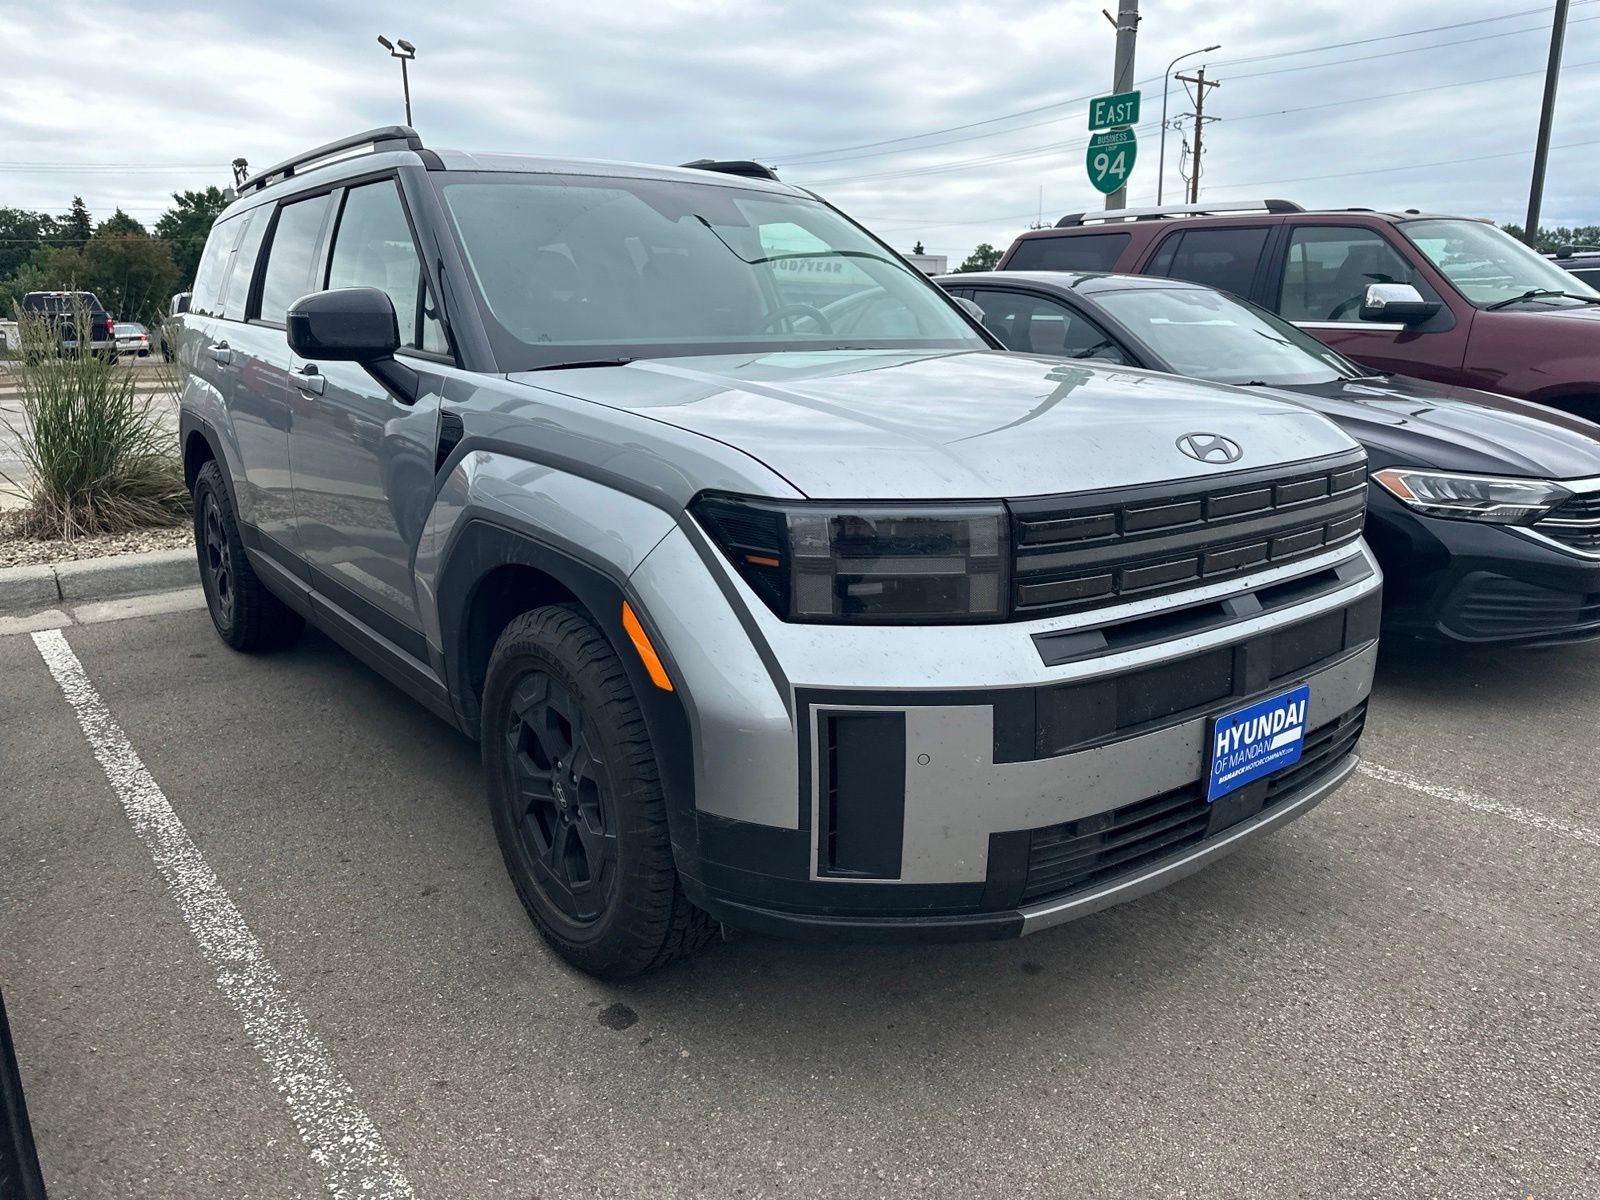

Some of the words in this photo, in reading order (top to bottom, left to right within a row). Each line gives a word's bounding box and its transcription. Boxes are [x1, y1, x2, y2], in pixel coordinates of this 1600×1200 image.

[1095, 101, 1133, 126] EAST
[1097, 132, 1128, 145] BUSINESS
[1093, 151, 1126, 182] 94
[1216, 700, 1306, 758] HYUNDAI
[1214, 756, 1228, 775] OF
[1229, 738, 1272, 769] MANDAN
